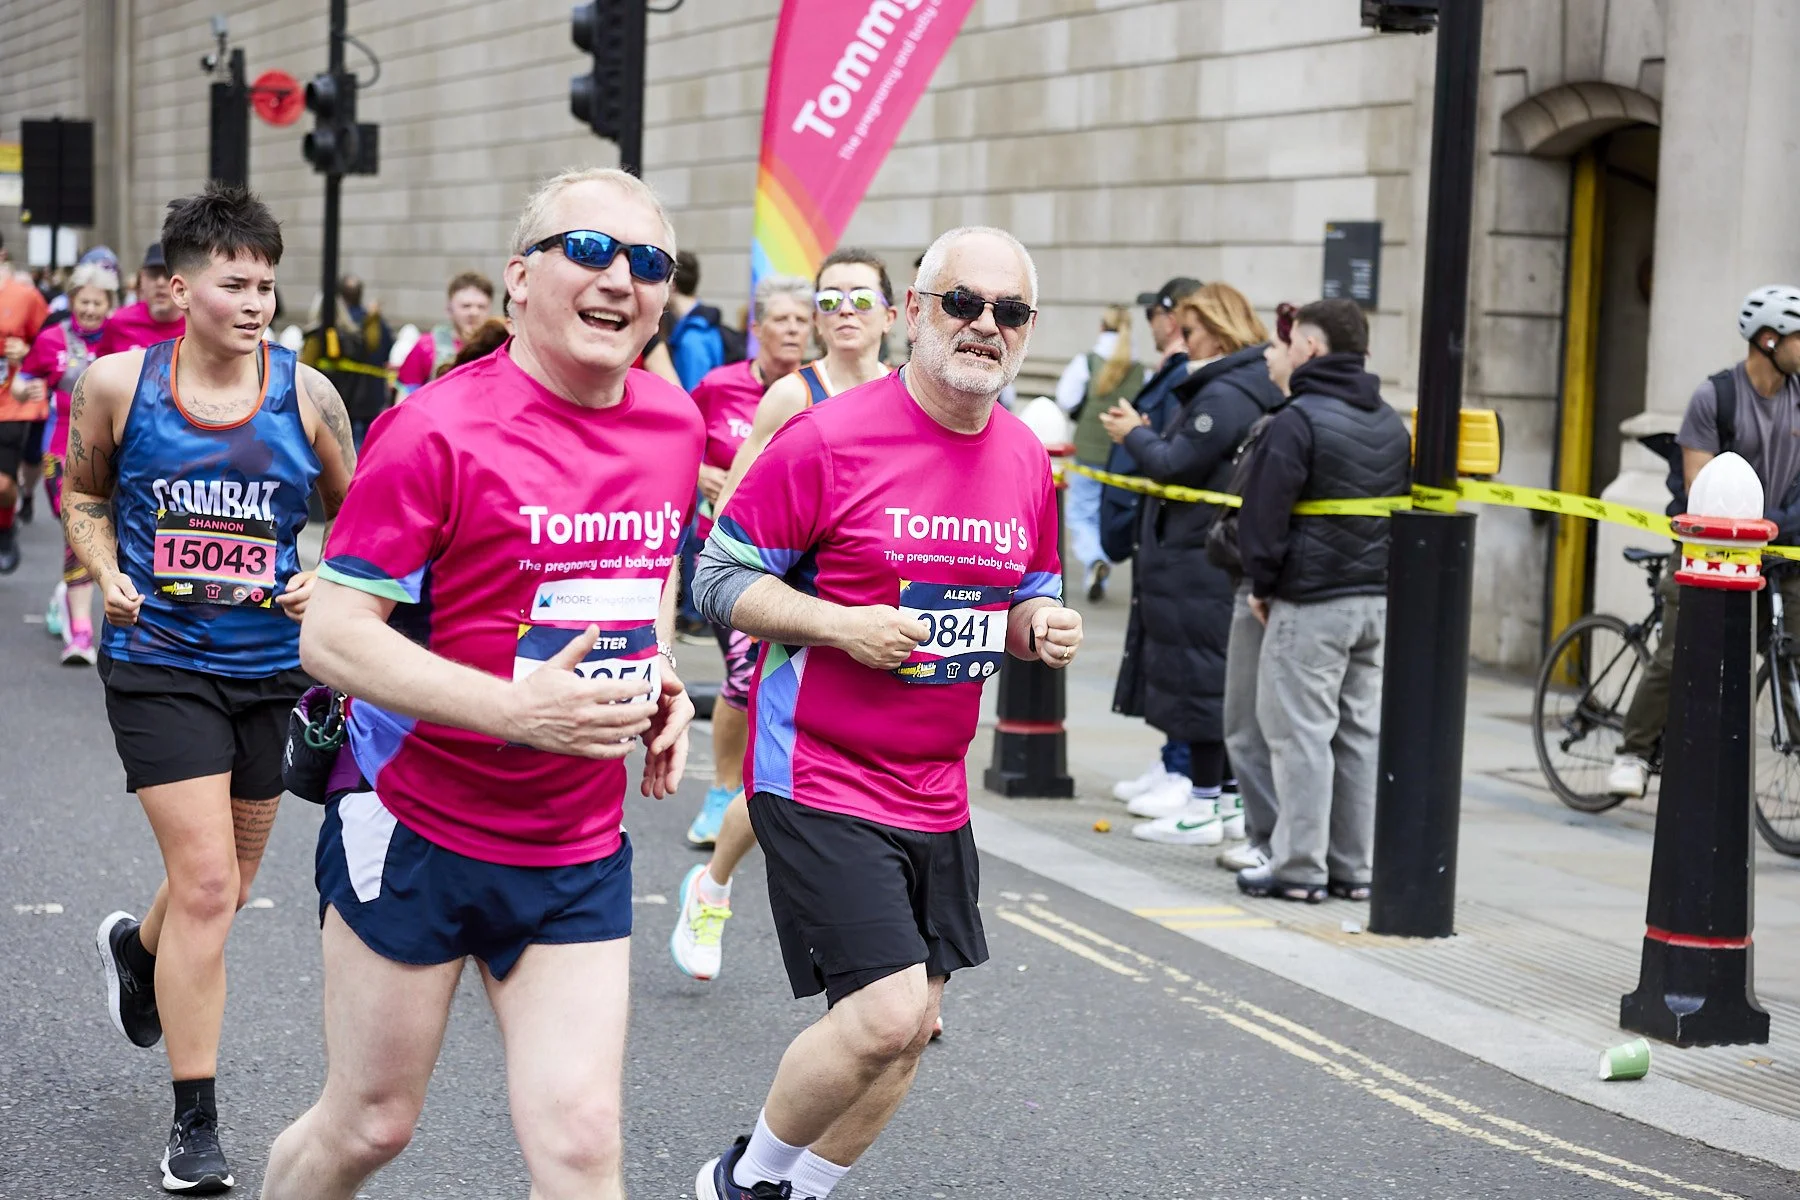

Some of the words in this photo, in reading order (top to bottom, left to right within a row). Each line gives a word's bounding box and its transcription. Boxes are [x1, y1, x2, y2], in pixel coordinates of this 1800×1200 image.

[152, 478, 280, 521] COMBAT
[188, 517, 245, 533] SHANNON
[518, 501, 681, 551] Tommy's
[884, 507, 1028, 555] Tommy's
[163, 538, 267, 576] 15043
[518, 559, 542, 571] The
[544, 558, 598, 573] pregnancy
[600, 555, 622, 569] and
[625, 554, 654, 570] baby
[884, 550, 904, 561] The
[907, 552, 956, 565] pregnancy
[957, 555, 976, 565] and
[978, 555, 1003, 570] baby
[555, 595, 592, 605] MOORE
[943, 589, 982, 601] ALEXIS
[592, 636, 628, 650] ETER
